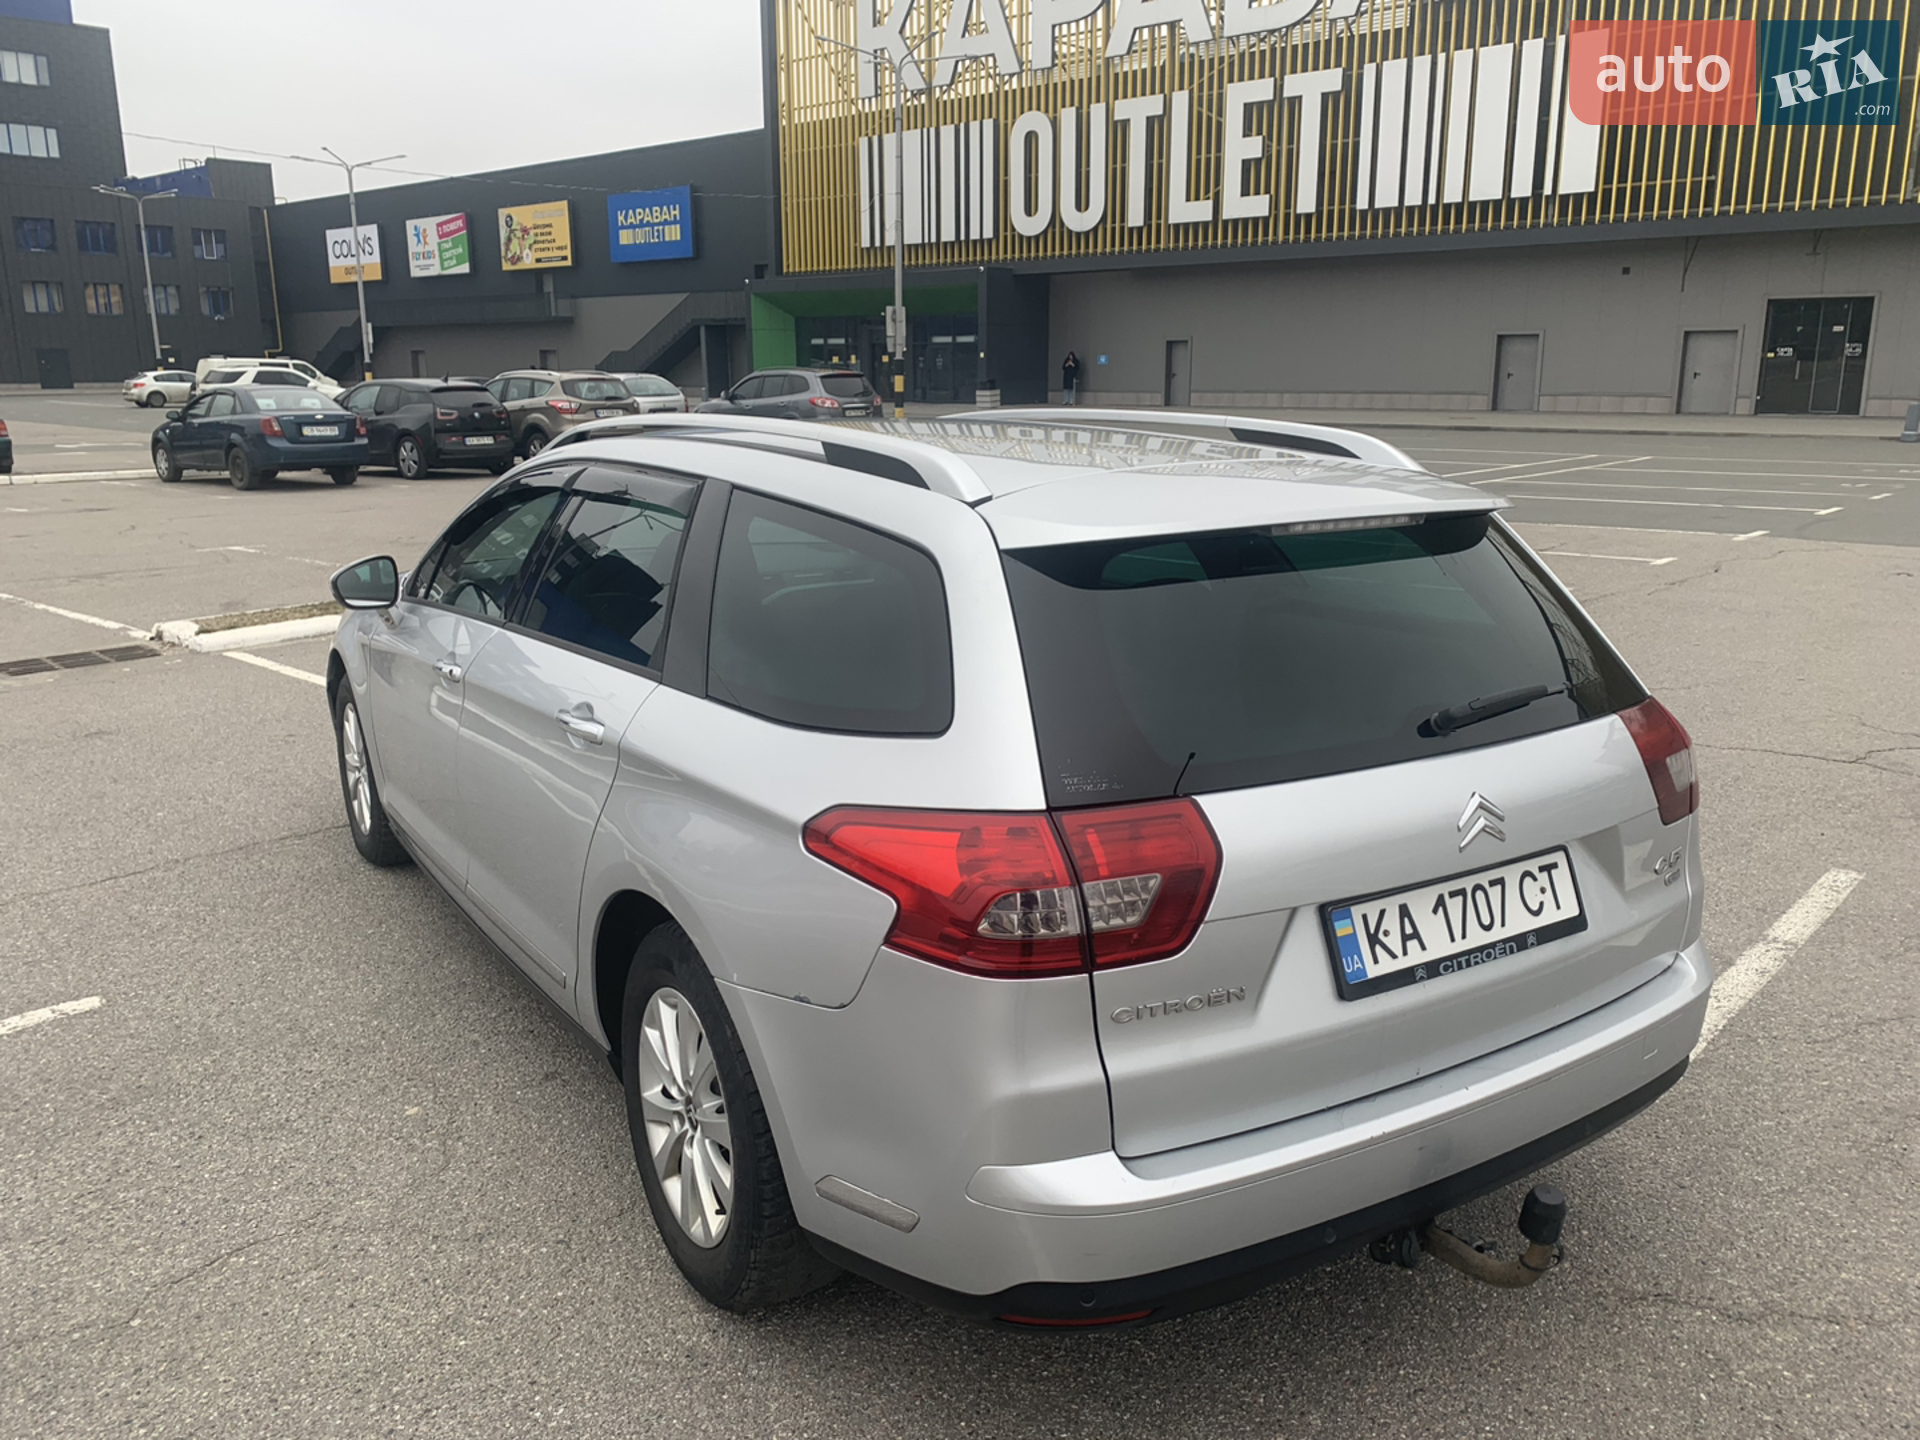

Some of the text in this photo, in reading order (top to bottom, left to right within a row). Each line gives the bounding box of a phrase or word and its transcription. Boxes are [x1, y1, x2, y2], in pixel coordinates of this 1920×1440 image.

[1009, 67, 1343, 237] OUTLET
[617, 204, 680, 226] КАРАВАН
[332, 234, 374, 259] COLN'S
[635, 225, 664, 244] OUTLET
[1361, 861, 1561, 965] KA 1707 CT
[1342, 952, 1363, 973] UA
[1110, 985, 1246, 1024] CITROËN
